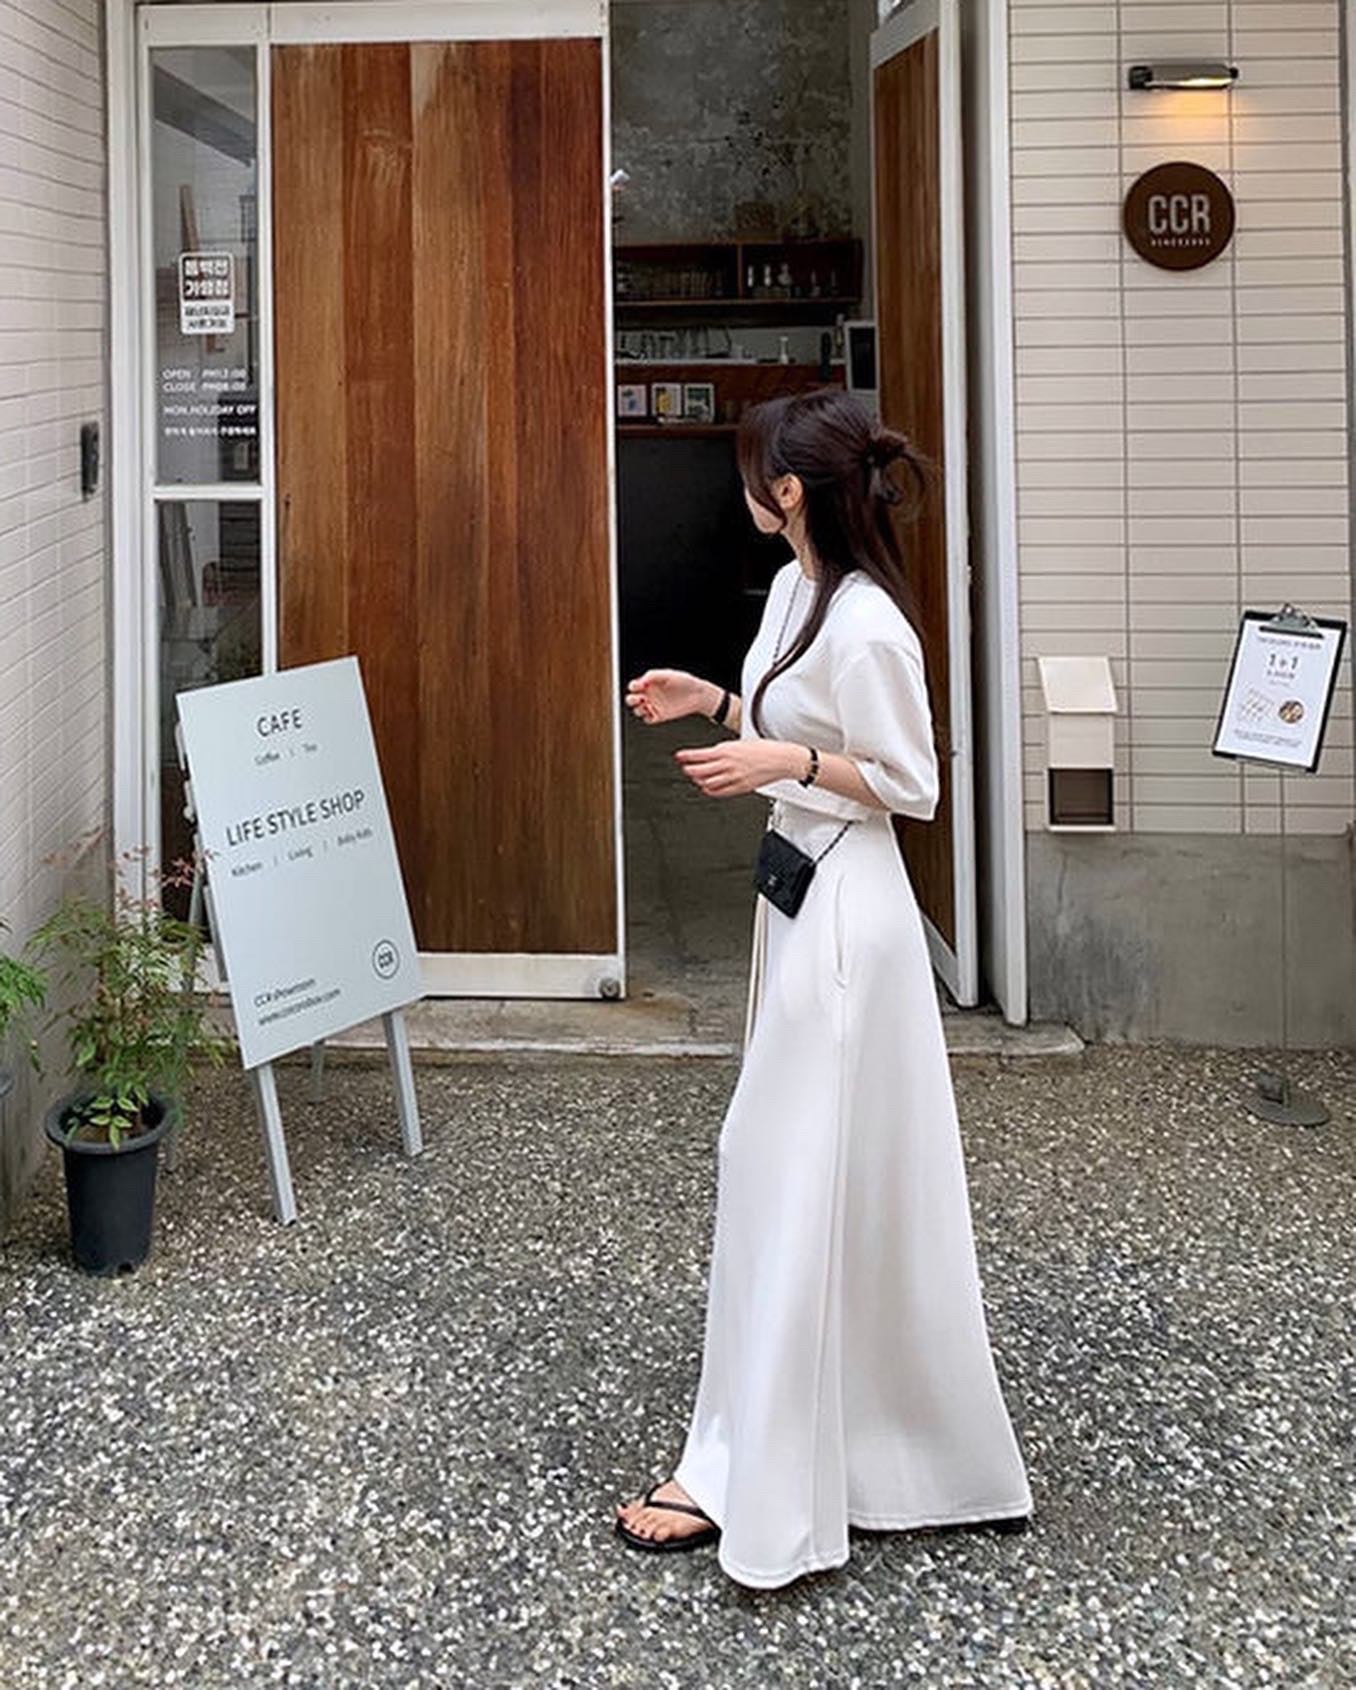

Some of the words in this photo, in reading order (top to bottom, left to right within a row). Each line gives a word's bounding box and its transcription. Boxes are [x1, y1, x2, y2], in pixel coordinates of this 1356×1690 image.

[1148, 194, 1211, 234] CCR
[162, 369, 191, 379] OPEN
[162, 382, 196, 392] CLOSE
[236, 405, 256, 415] OFF
[257, 709, 302, 737] CAFE
[226, 817, 265, 846] LIFE
[266, 802, 317, 835] STYLE
[319, 790, 365, 820] SHOP
